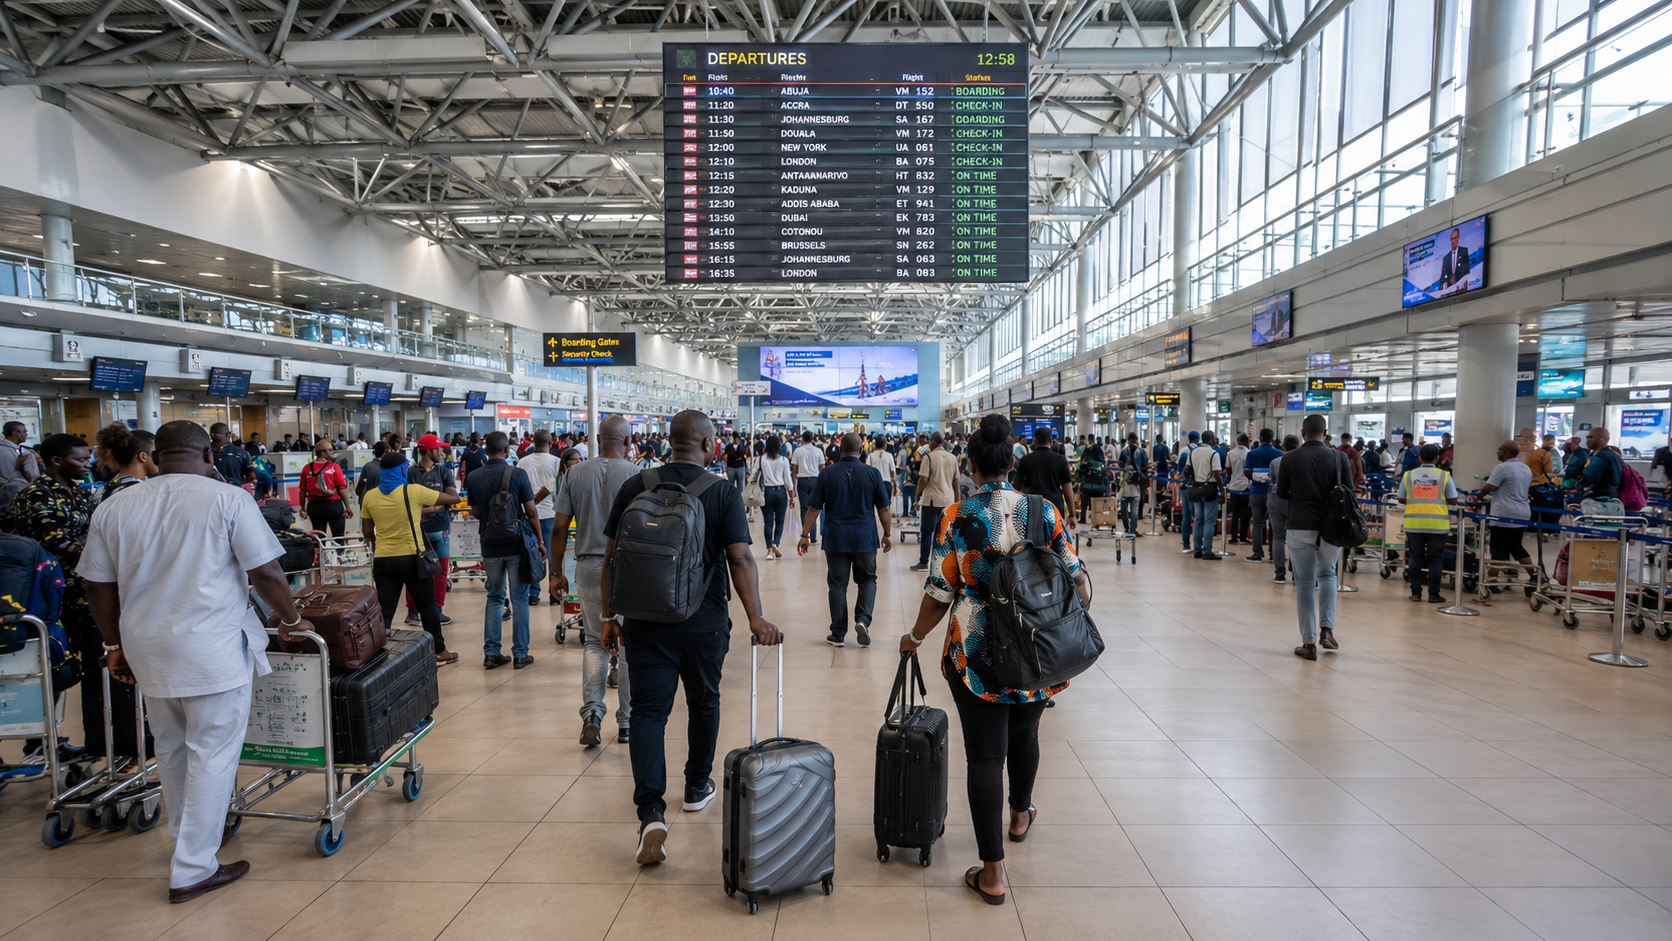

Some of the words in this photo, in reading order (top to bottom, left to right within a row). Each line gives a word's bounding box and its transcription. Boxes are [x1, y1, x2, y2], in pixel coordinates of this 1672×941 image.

[708, 52, 807, 65] DEPARTURES
[977, 53, 1015, 65] 12:58
[708, 87, 735, 96] 10:40
[781, 87, 810, 96] ABUJA
[895, 87, 910, 96] VM
[916, 87, 935, 96] 152
[955, 87, 1005, 96] BOARDING
[708, 101, 735, 110] 11:20
[781, 101, 812, 110] ACCRA
[895, 101, 908, 110] DT
[955, 101, 1002, 110] CHECK-IN
[708, 115, 735, 124] 11:30
[781, 115, 850, 124] JOHANNESBURG
[895, 115, 909, 124] SA
[916, 115, 935, 124] 167
[708, 129, 735, 138] 11:50
[781, 129, 816, 138] DOUALA
[895, 129, 910, 138] VM
[916, 129, 935, 138] 172
[955, 129, 1002, 138] CHECK-IN
[708, 143, 735, 152] 12:00
[781, 143, 801, 152] NEW
[803, 143, 827, 152] YORK
[895, 143, 909, 152] UA
[955, 143, 1002, 152] CHECK-IN
[708, 157, 735, 166] 12:10
[781, 157, 817, 166] LONDON
[895, 157, 909, 166] BA
[916, 157, 935, 166] 075
[955, 157, 1002, 166] CHECK-IN
[708, 171, 735, 180] 12:15
[895, 171, 909, 180] HT
[916, 171, 935, 180] 832
[956, 171, 971, 180] ON
[973, 171, 997, 180] TIME
[708, 185, 735, 194] 12:20
[781, 185, 818, 194] KADUNA
[895, 185, 910, 194] VM
[916, 185, 935, 194] 129
[956, 185, 971, 194] ON
[973, 185, 997, 194] TIME
[708, 199, 735, 208] 12:30
[781, 199, 808, 208] ADDIS
[810, 199, 840, 208] ABABA
[895, 199, 909, 208] ET
[916, 199, 935, 208] 941
[956, 199, 971, 208] ON
[708, 213, 735, 222] 13:50
[781, 213, 808, 222] DUBAI
[895, 213, 909, 222] EK
[956, 213, 971, 222] ON
[973, 213, 997, 222] TIME
[708, 227, 735, 236] 14:10
[895, 227, 910, 236] VM
[916, 227, 935, 236] 820
[956, 227, 971, 236] ON
[973, 227, 997, 236] TIME
[781, 241, 826, 250] BRUSSELS
[895, 240, 910, 249] SN
[916, 240, 935, 249] 262
[956, 240, 971, 249] ON
[973, 240, 997, 249] TIME
[708, 255, 735, 264] 16:15
[781, 255, 851, 264] JOHANNESBURG
[895, 254, 910, 263] SA
[956, 254, 971, 263] ON
[973, 254, 997, 263] TIME
[708, 269, 735, 278] 16:35
[895, 268, 910, 277] BA
[956, 268, 971, 277] ON
[973, 268, 997, 277] TIME
